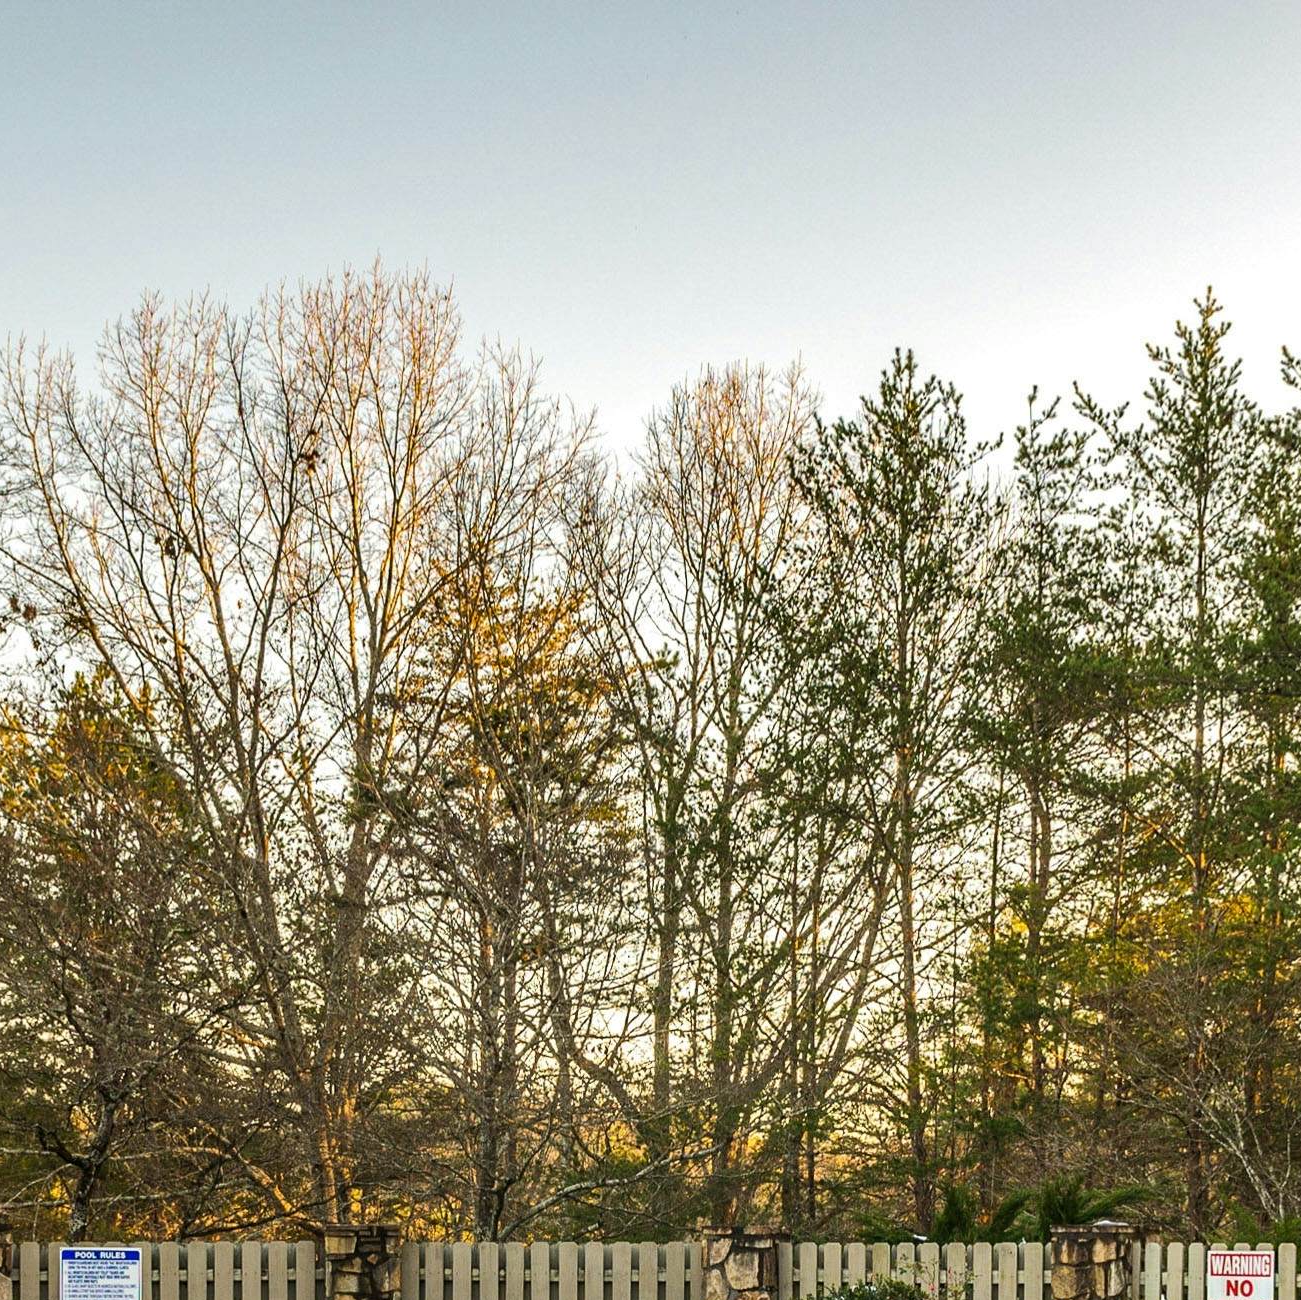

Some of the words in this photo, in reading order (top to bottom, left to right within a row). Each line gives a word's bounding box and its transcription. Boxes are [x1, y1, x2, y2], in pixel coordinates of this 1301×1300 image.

[75, 1251, 97, 1259] POOL
[100, 1251, 126, 1259] RULES
[1211, 1254, 1270, 1276] WARNING
[1226, 1279, 1254, 1297] NO
